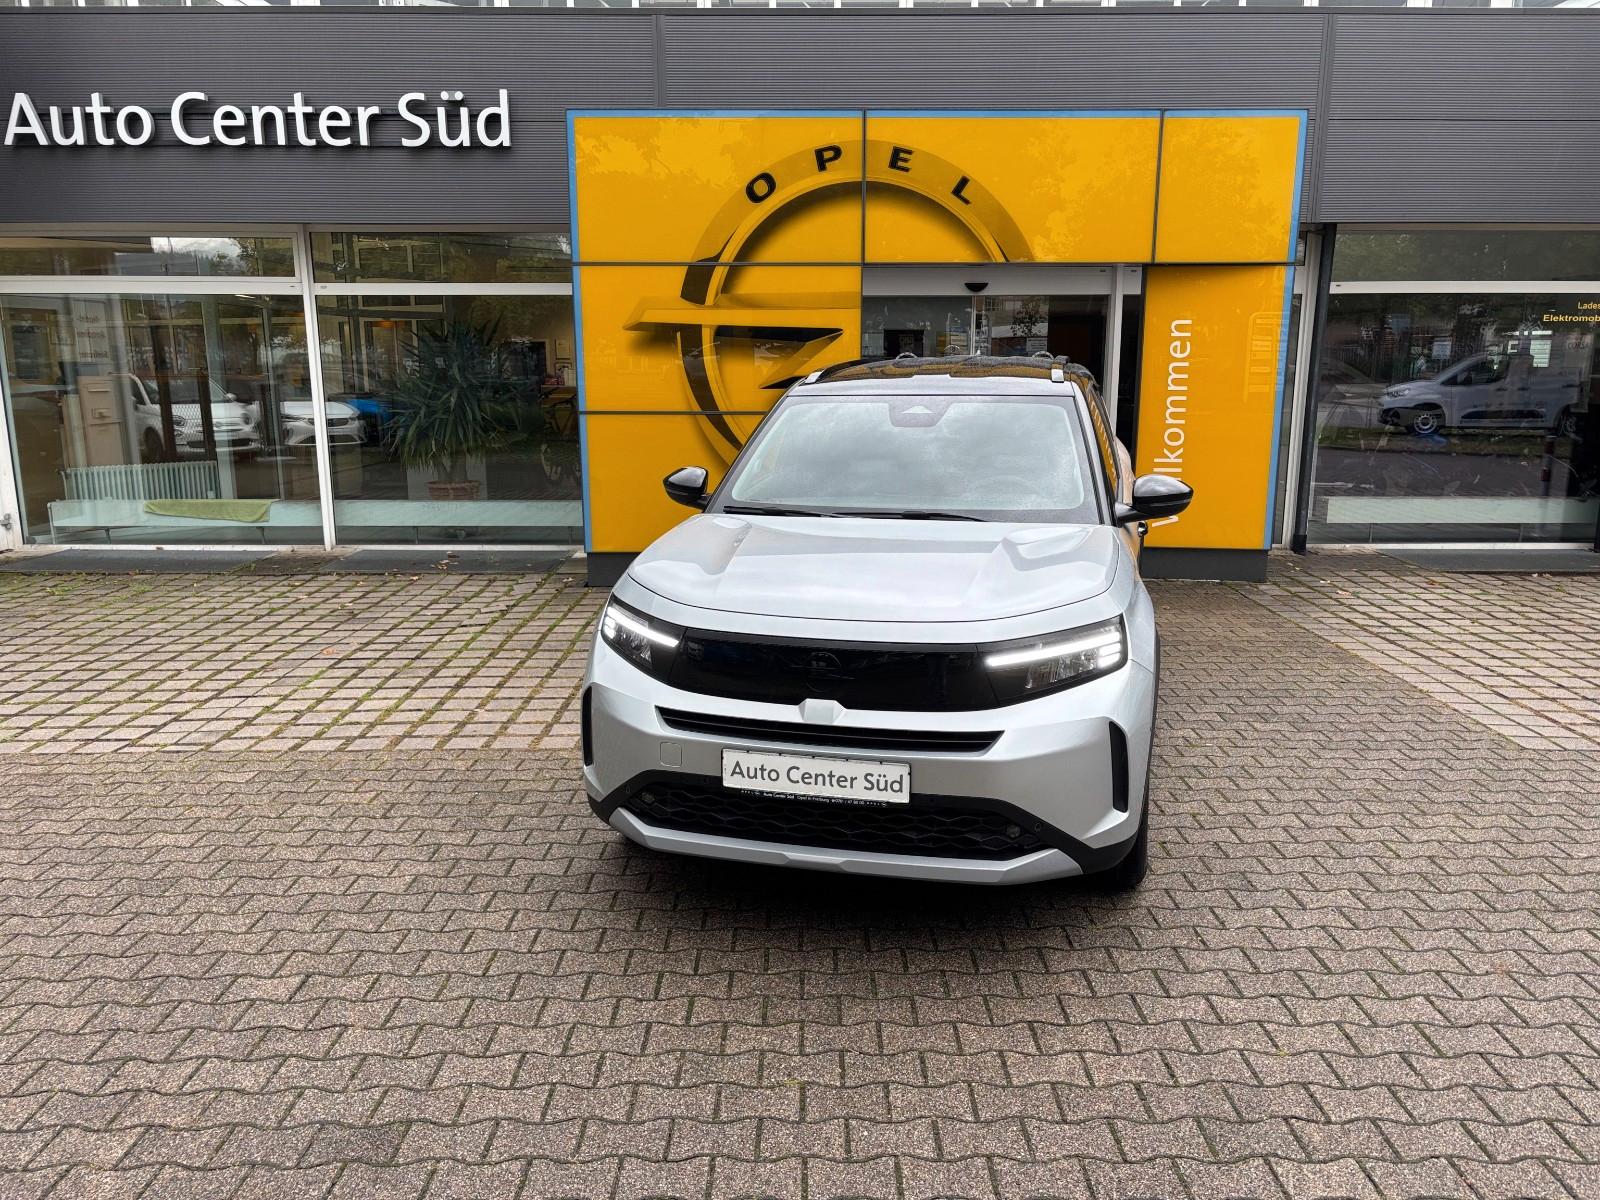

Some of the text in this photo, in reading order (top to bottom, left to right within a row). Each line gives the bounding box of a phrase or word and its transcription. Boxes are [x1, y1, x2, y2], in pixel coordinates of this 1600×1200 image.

[4, 89, 512, 148] Auto Center Süd
[745, 144, 972, 205] OPEL
[1152, 319, 1192, 527] lkommen
[730, 760, 904, 794] Auto Center Süd
